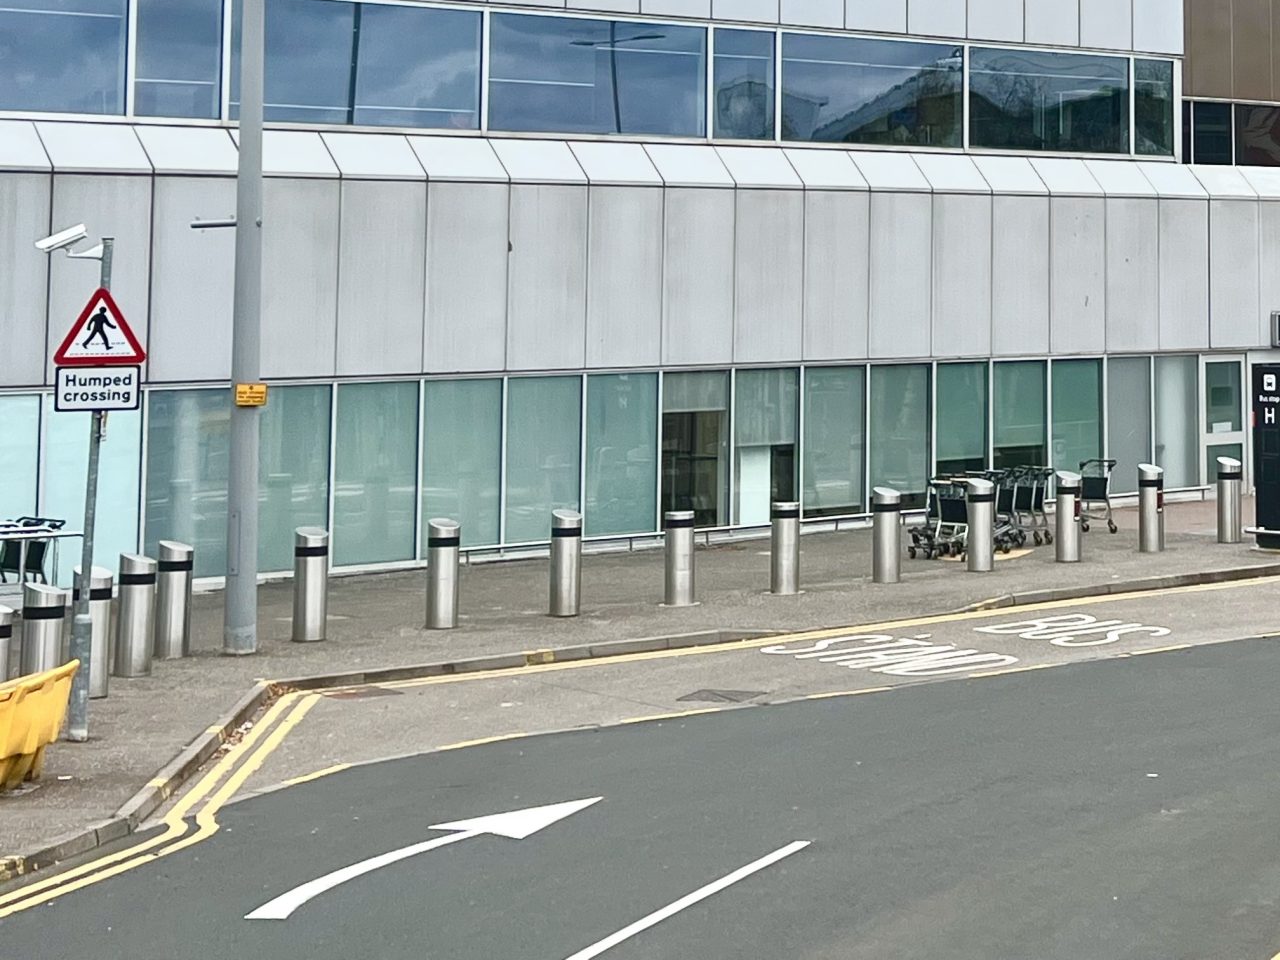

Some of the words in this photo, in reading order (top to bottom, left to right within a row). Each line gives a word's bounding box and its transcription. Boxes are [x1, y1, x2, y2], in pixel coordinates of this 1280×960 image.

[65, 374, 132, 387] Humped
[64, 389, 131, 402] crossing
[1264, 407, 1275, 424] H
[973, 613, 1172, 647] BUS
[760, 634, 1018, 676] STAND
